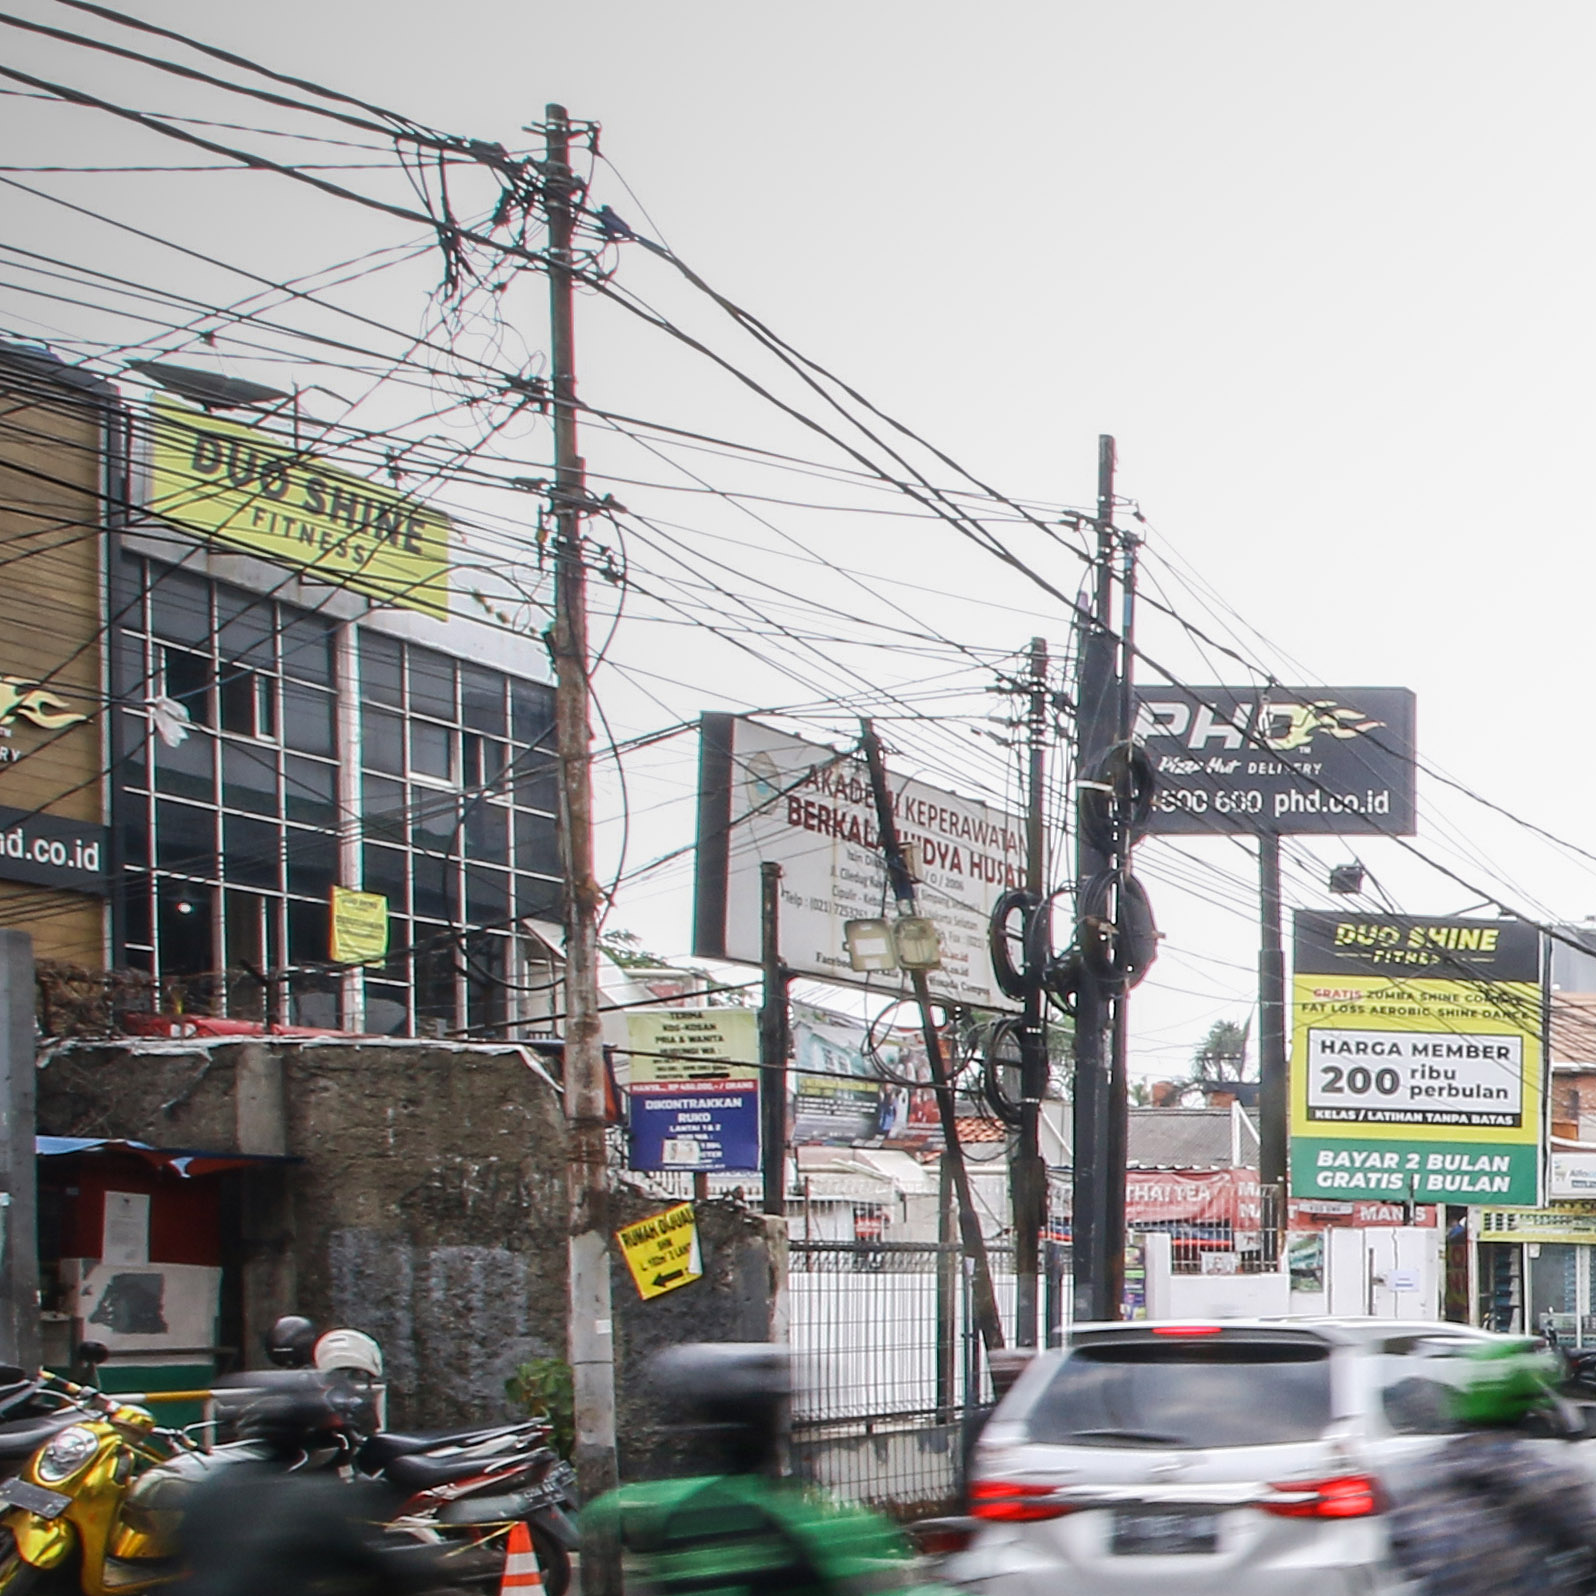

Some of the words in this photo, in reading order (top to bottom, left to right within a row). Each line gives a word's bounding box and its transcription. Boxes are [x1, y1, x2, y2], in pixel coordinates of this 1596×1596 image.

[192, 434, 290, 500] DUO
[302, 476, 426, 556] SHINE
[252, 506, 367, 564] FITNESS
[1131, 702, 1312, 751] PHD
[1206, 756, 1242, 774] Hut
[805, 764, 901, 818] AKADEI
[1215, 789, 1263, 814] 600
[1275, 790, 1390, 818] phd.co.id
[787, 794, 888, 851] BERKAL
[970, 850, 1029, 891] HUSAD
[1334, 923, 1400, 948] DUO
[1407, 925, 1500, 951] SHINE
[1372, 950, 1446, 966] FITNE
[1313, 988, 1363, 1000] GRATIS
[1420, 992, 1460, 1003] SHINE
[1301, 1004, 1326, 1014] FAT
[1331, 1005, 1366, 1015] LOSS
[1370, 1006, 1431, 1018] AEROBIC
[1438, 1008, 1478, 1019] SHINE
[1320, 1040, 1403, 1056] HARGA
[1412, 1043, 1511, 1061] MEMBER
[1320, 1065, 1400, 1095] 200
[1410, 1063, 1456, 1080] ribu
[1410, 1083, 1509, 1101] perbulan
[1315, 1109, 1356, 1121] KELAS
[1367, 1111, 1424, 1123] LATIHAN
[1425, 1113, 1469, 1124] TANPA
[1471, 1114, 1514, 1126] BATAS
[1317, 1150, 1399, 1169] BAYAR
[1405, 1153, 1421, 1170] 2
[1427, 1155, 1510, 1172] BULAN
[1174, 1184, 1211, 1201] TEA
[1317, 1171, 1404, 1190] GRATIS
[1427, 1175, 1511, 1193] BULAN
[1360, 1204, 1426, 1222] MANS
